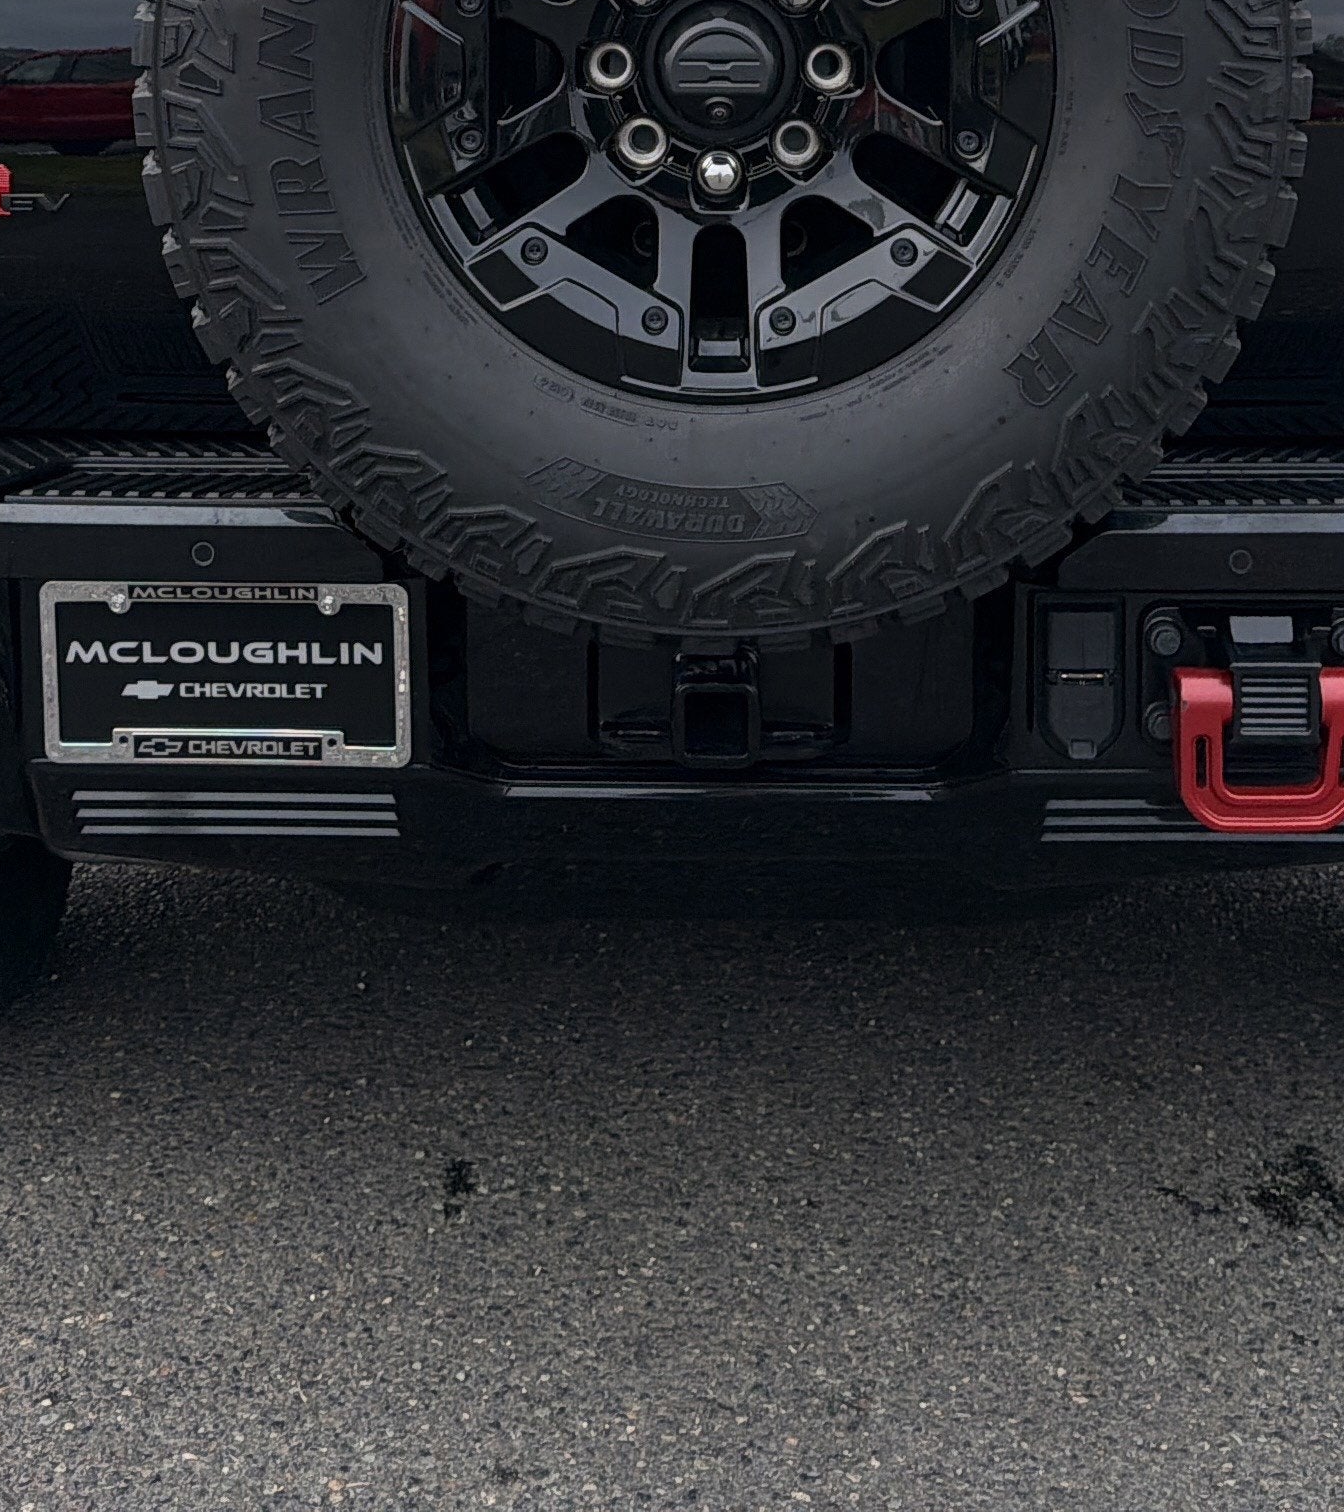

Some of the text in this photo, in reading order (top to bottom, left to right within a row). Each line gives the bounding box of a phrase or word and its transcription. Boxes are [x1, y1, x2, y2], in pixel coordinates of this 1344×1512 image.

[614, 484, 731, 509] TECHNOLOGY
[592, 498, 746, 534] DURAWALL
[132, 587, 316, 600] MCLOUGHLIN
[65, 640, 383, 665] MCLOUGHLIN
[179, 682, 328, 700] CHEVROLET
[188, 739, 319, 756] CHEVROLET
